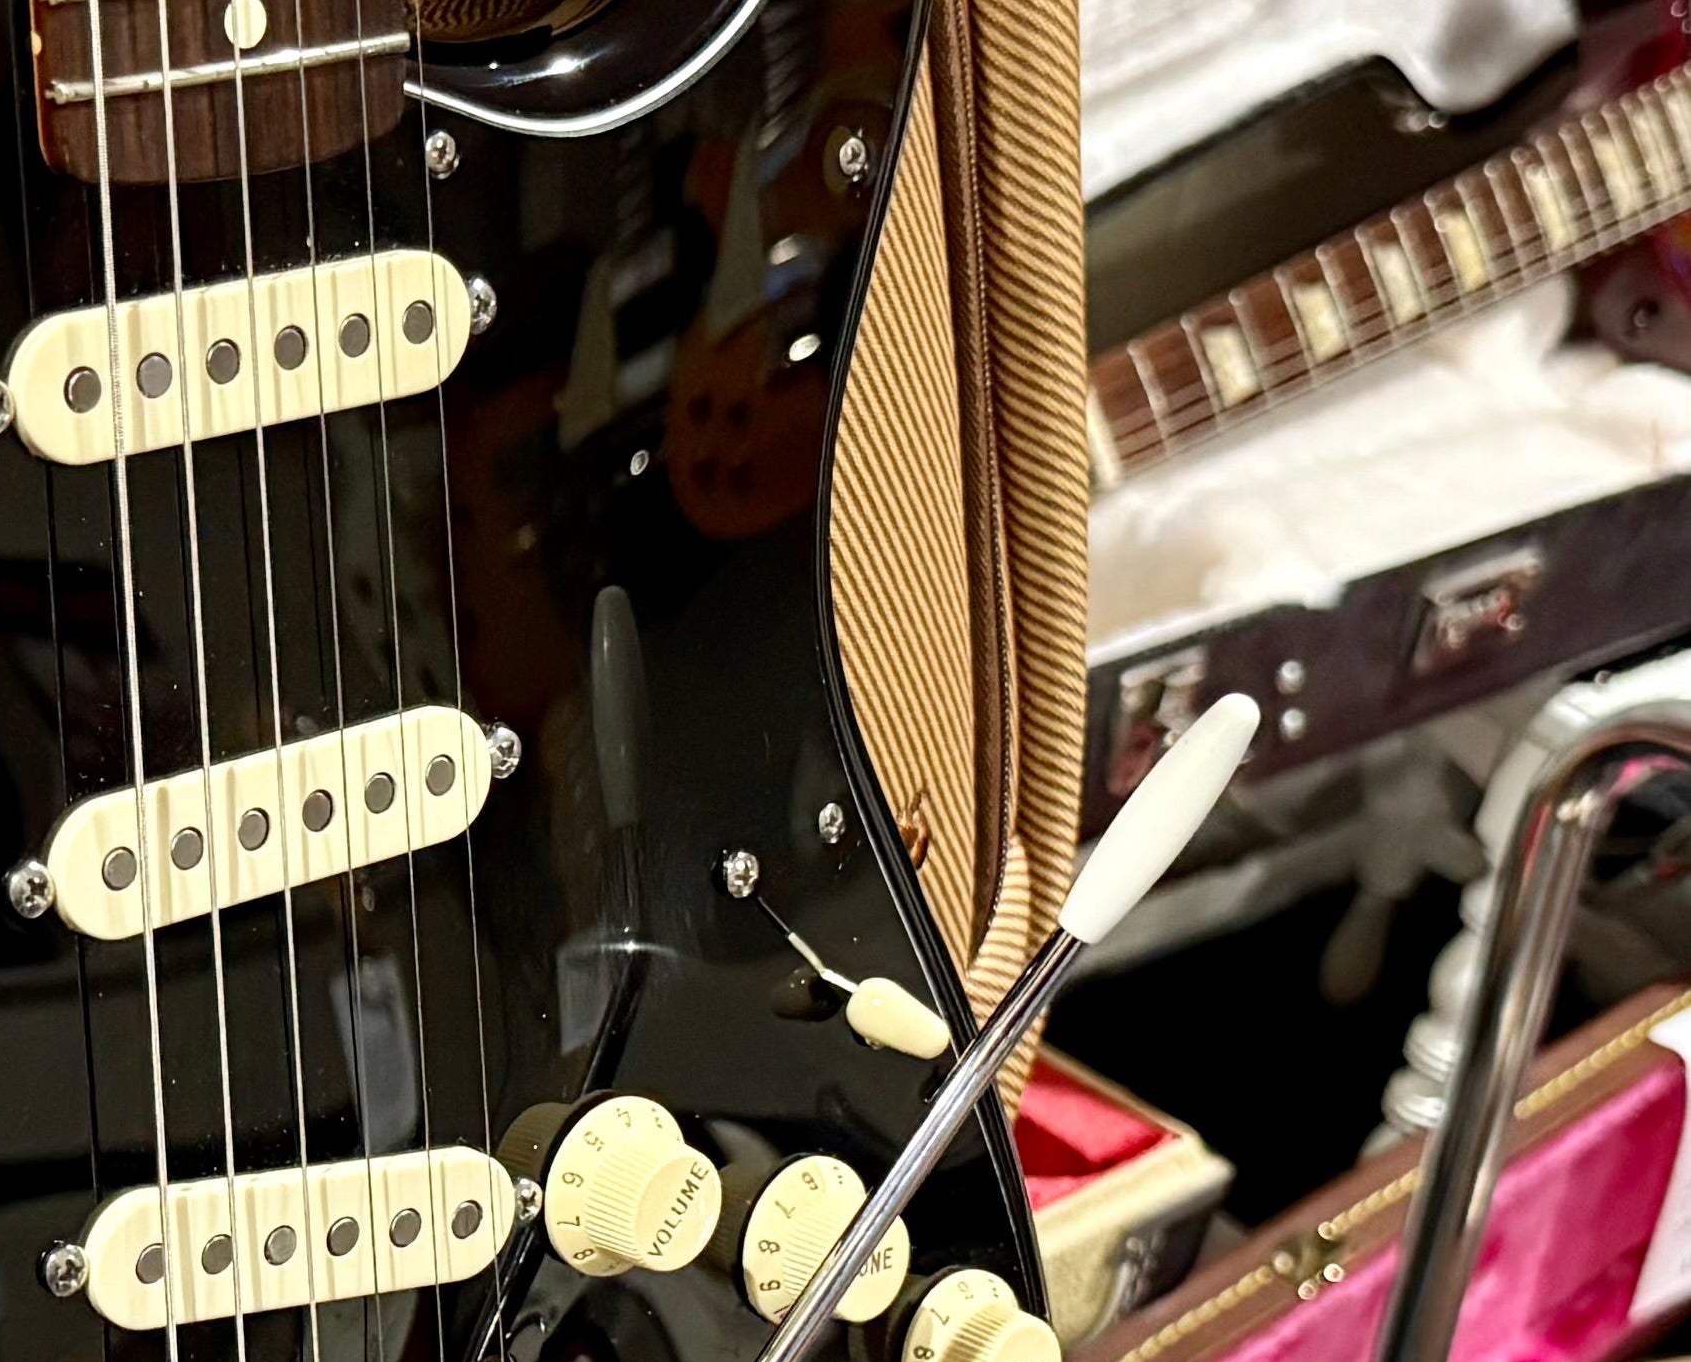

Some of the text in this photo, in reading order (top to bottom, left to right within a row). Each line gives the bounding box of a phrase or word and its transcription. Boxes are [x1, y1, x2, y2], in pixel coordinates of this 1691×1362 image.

[647, 1161, 709, 1257] VOLUME
[557, 1215, 581, 1227] 7
[573, 1248, 595, 1261] 8
[758, 1239, 781, 1255] 8
[859, 1246, 894, 1277] ONE
[929, 1308, 950, 1326] 7
[913, 1345, 934, 1360] 8
